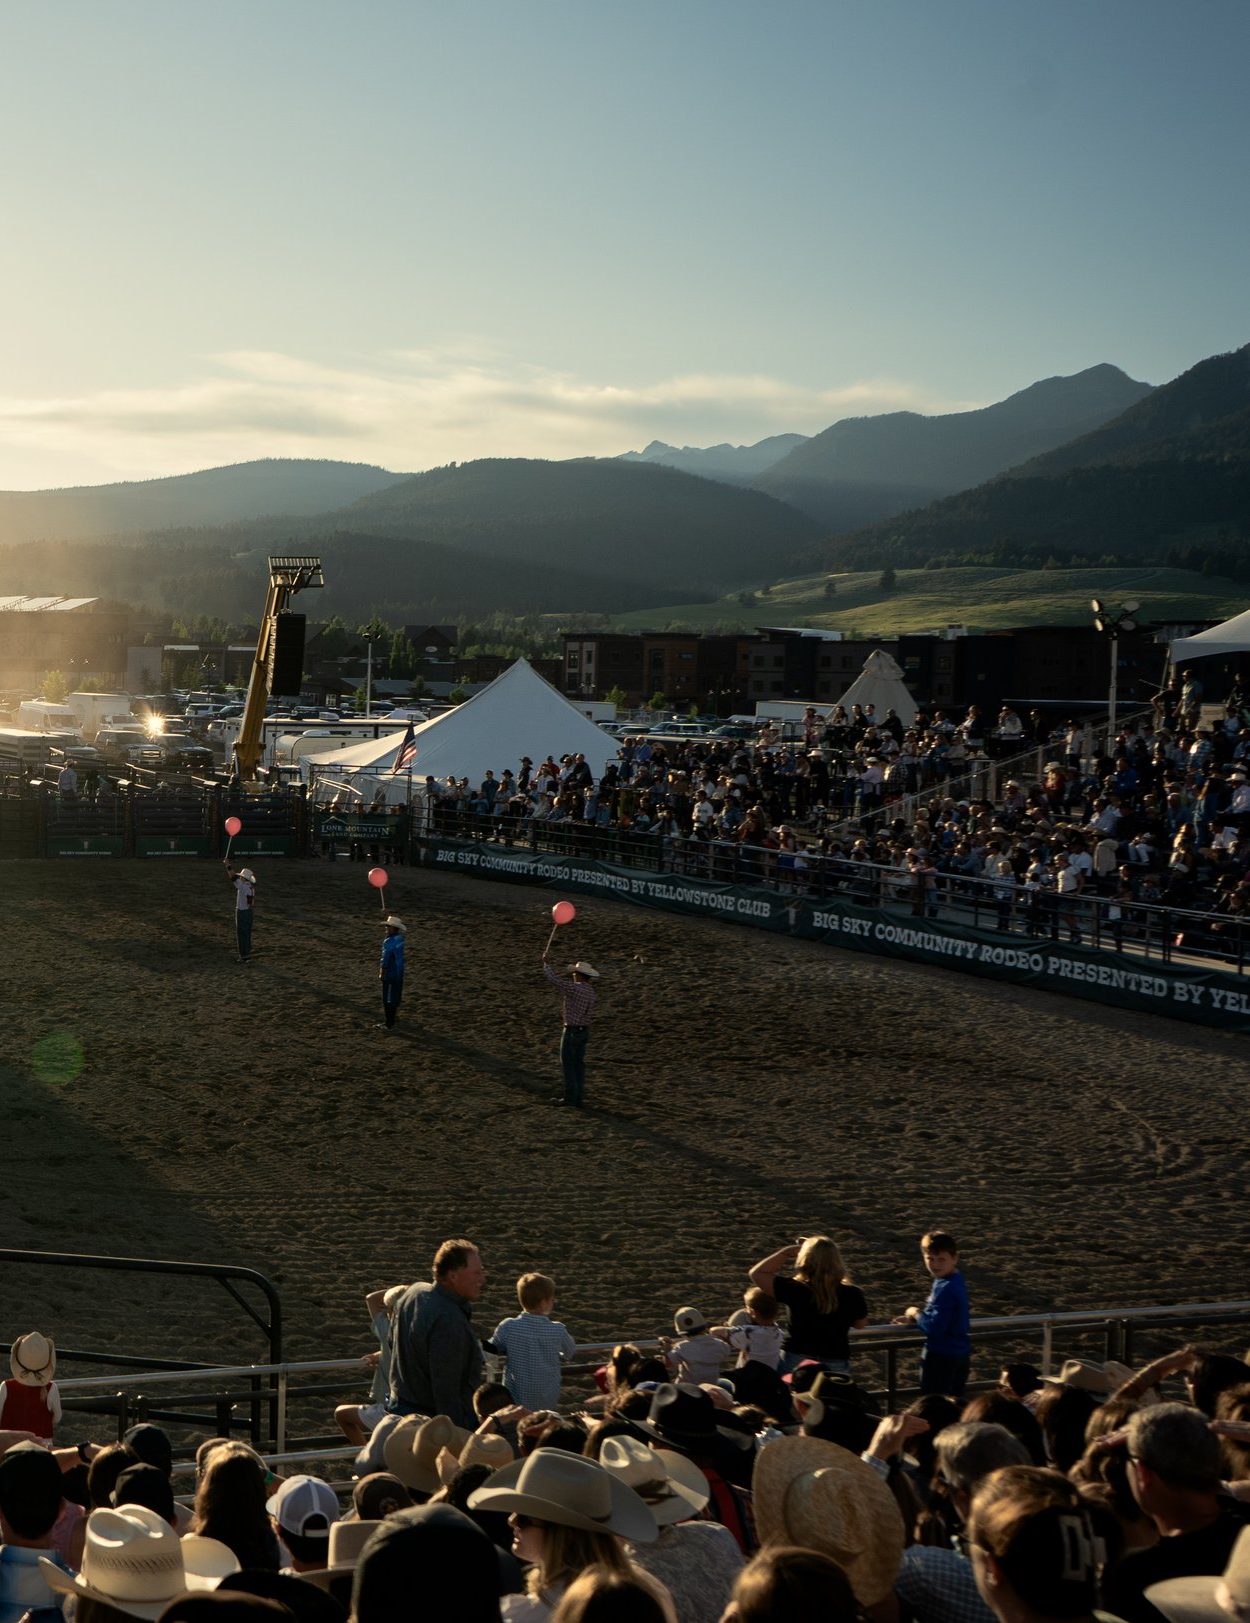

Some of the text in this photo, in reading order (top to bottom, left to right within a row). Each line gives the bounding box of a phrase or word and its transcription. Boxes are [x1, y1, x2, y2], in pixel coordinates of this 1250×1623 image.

[345, 825, 390, 836] MOUNTAIN
[436, 850, 771, 918] BIG SKY COMMUNITY RODEO PRESENTED BY YELLOWSTONE CLUB
[812, 911, 1250, 1015] BIG SKY COMMUNITY RODEO PRESENTED BY YEL
